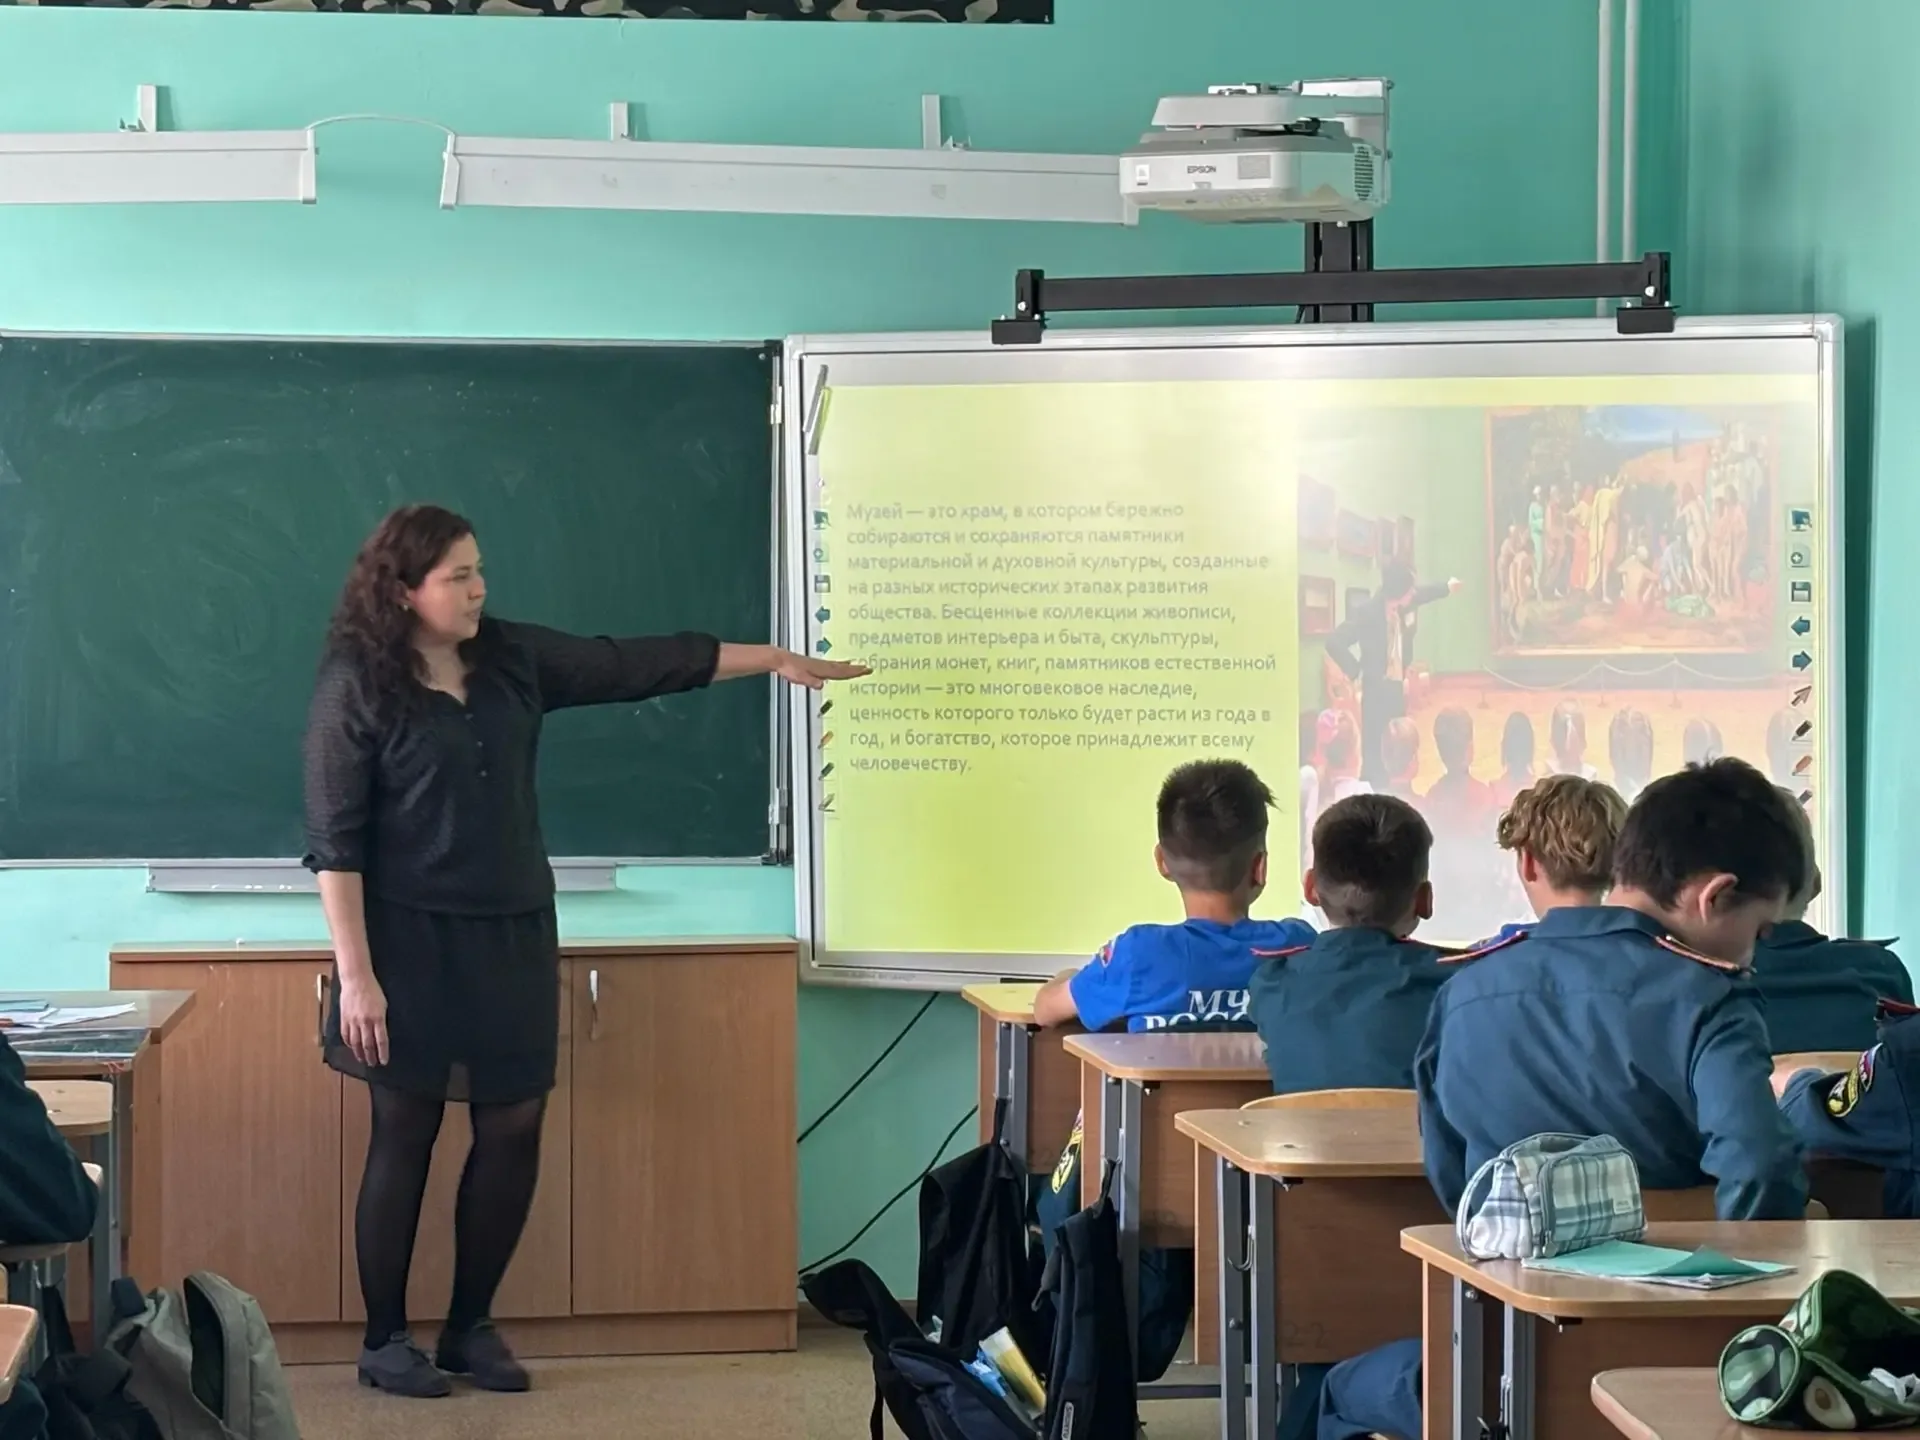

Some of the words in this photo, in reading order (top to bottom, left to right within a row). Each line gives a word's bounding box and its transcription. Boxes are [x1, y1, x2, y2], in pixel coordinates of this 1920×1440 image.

[1187, 165, 1216, 174] EPSON
[847, 502, 903, 524] Музей
[929, 506, 957, 519] это
[961, 506, 1007, 522] храм,
[1013, 506, 1023, 518] в
[1027, 505, 1101, 522] котором
[1105, 501, 1184, 521] бережно
[847, 527, 950, 548] собираются
[955, 532, 965, 545] и
[970, 531, 1083, 548] сохраняются
[1088, 531, 1184, 543] памятники
[848, 552, 973, 573] материальной
[977, 557, 988, 569] и
[992, 553, 1076, 573] духовной
[1081, 556, 1167, 573] культуры,
[1173, 556, 1268, 571] созданные
[848, 582, 868, 594] на
[873, 582, 934, 598] разных
[939, 582, 1059, 599] исторических
[1064, 581, 1123, 594] этапах
[1127, 581, 1208, 598] развития
[849, 603, 937, 622] общества.
[942, 604, 1037, 622] Бесценные
[1043, 607, 1137, 622] коллекции
[1142, 607, 1235, 623] живописи,
[849, 633, 942, 649] предметов
[947, 633, 1039, 649] интерьера
[1044, 633, 1054, 644] и
[1058, 628, 1105, 649] быта,
[1111, 632, 1218, 649] скульптуры,
[936, 658, 991, 673] монет,
[997, 658, 1039, 675] книг,
[1045, 658, 1150, 670] памятников
[1154, 654, 1275, 670] естественной
[848, 681, 920, 700] истории
[946, 683, 975, 696] это
[980, 683, 1103, 695] многовековое
[1109, 683, 1196, 700] наследие,
[850, 708, 930, 723] ценность
[935, 708, 1014, 725] которого
[1019, 708, 1078, 720] только
[1083, 704, 1132, 724] будет
[1137, 709, 1186, 726] расти
[1192, 709, 1211, 722] из
[1216, 709, 1256, 724] года
[1262, 710, 1270, 721] в
[850, 733, 884, 749] год,
[891, 733, 900, 745] и
[905, 729, 995, 749] богатство,
[1001, 734, 1071, 750] которое
[1077, 734, 1197, 750] принадлежит
[1202, 735, 1254, 752] всему
[850, 758, 971, 775] человечеству.
